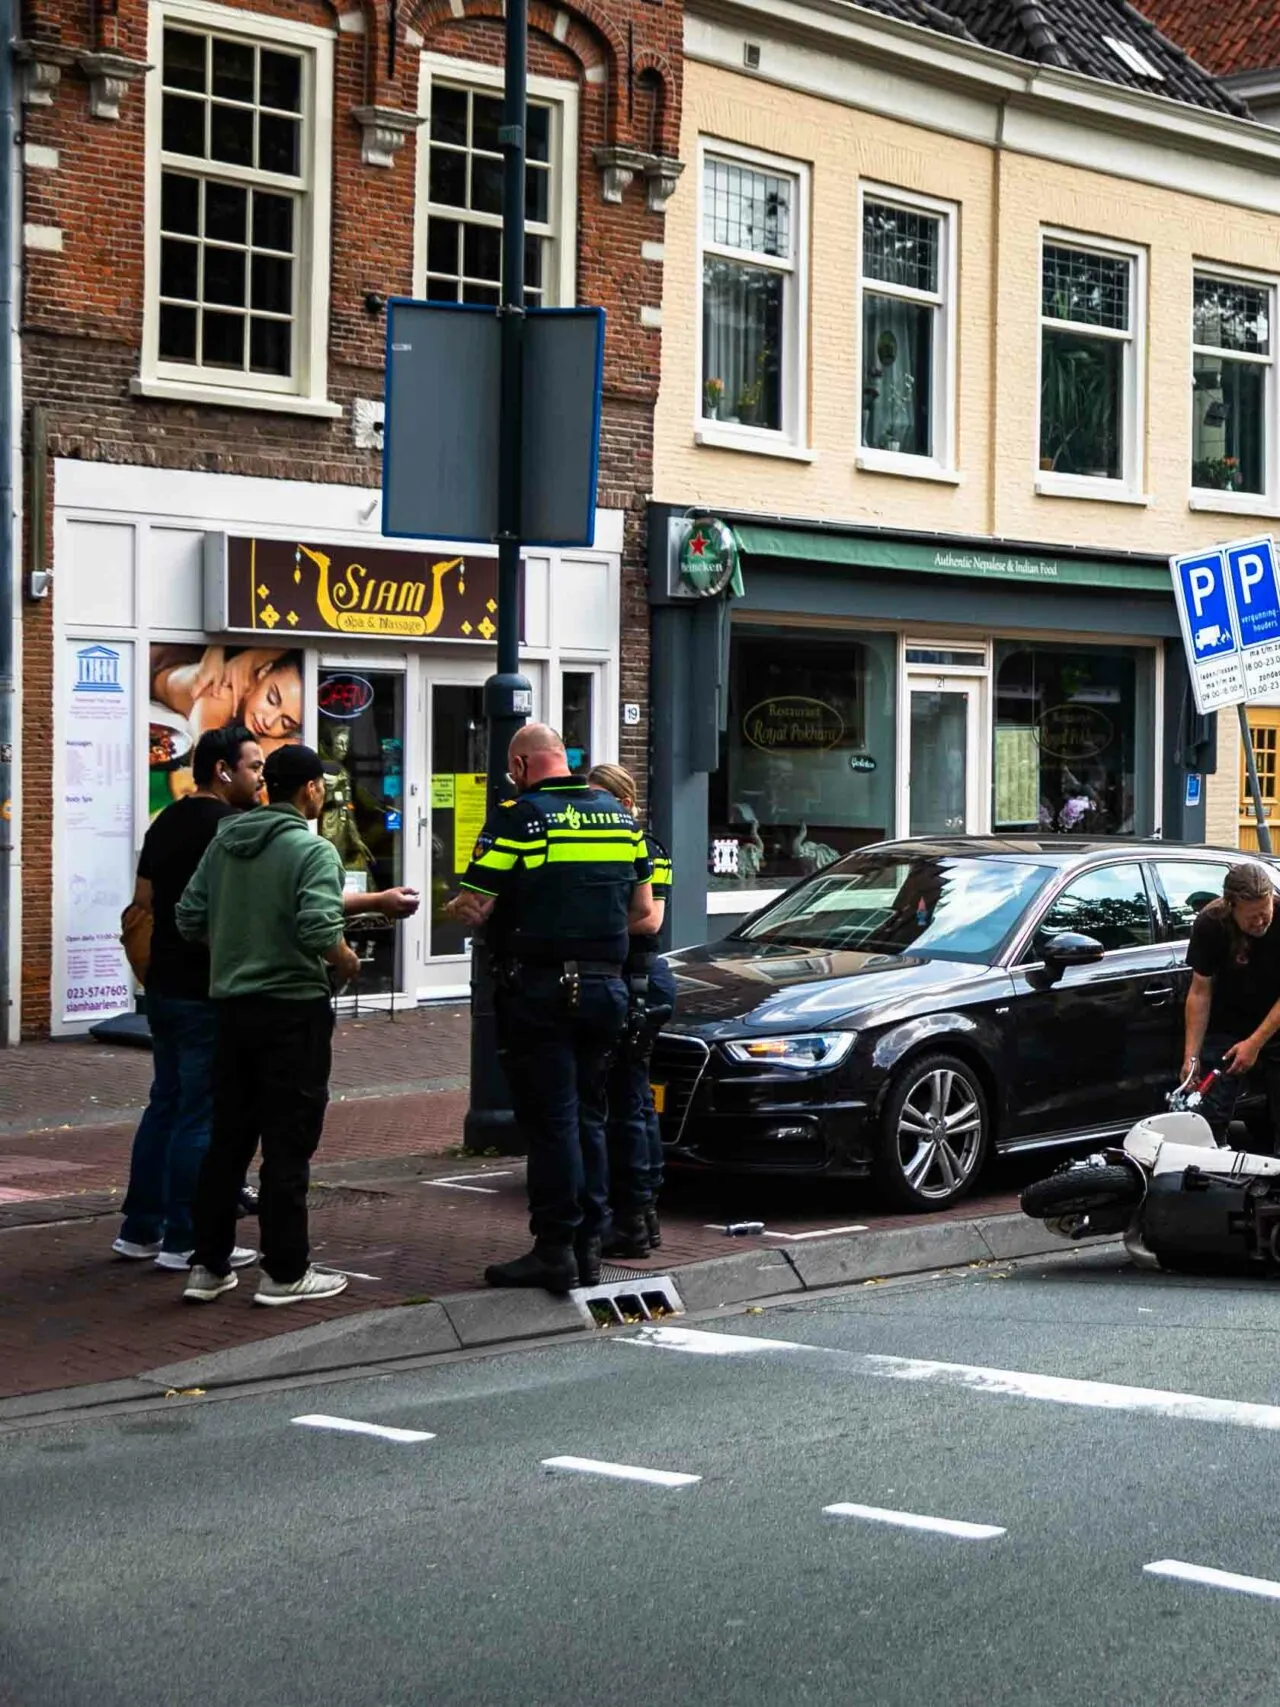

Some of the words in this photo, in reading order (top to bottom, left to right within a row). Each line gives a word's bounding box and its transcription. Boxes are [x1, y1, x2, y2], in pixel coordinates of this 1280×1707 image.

[933, 551, 973, 569] Authentic
[1007, 559, 1015, 572] &
[1015, 559, 1039, 573] Indian
[1039, 561, 1058, 576] Food
[1238, 554, 1264, 604] P
[1189, 567, 1215, 617] P
[344, 615, 365, 628] Spa
[367, 616, 375, 628] &
[378, 616, 421, 632] Massage
[1253, 620, 1278, 632] houders
[1250, 647, 1259, 657] ma
[1261, 645, 1273, 655] t/m
[1228, 676, 1236, 684] za
[318, 684, 366, 709] OPEN
[627, 707, 638, 720] 19
[768, 703, 821, 718] Restaurant
[753, 719, 788, 745] Royal
[557, 804, 621, 829] POLITIE
[66, 985, 128, 1000] 023-5747605
[66, 999, 128, 1013] siamhaarlem.nl
